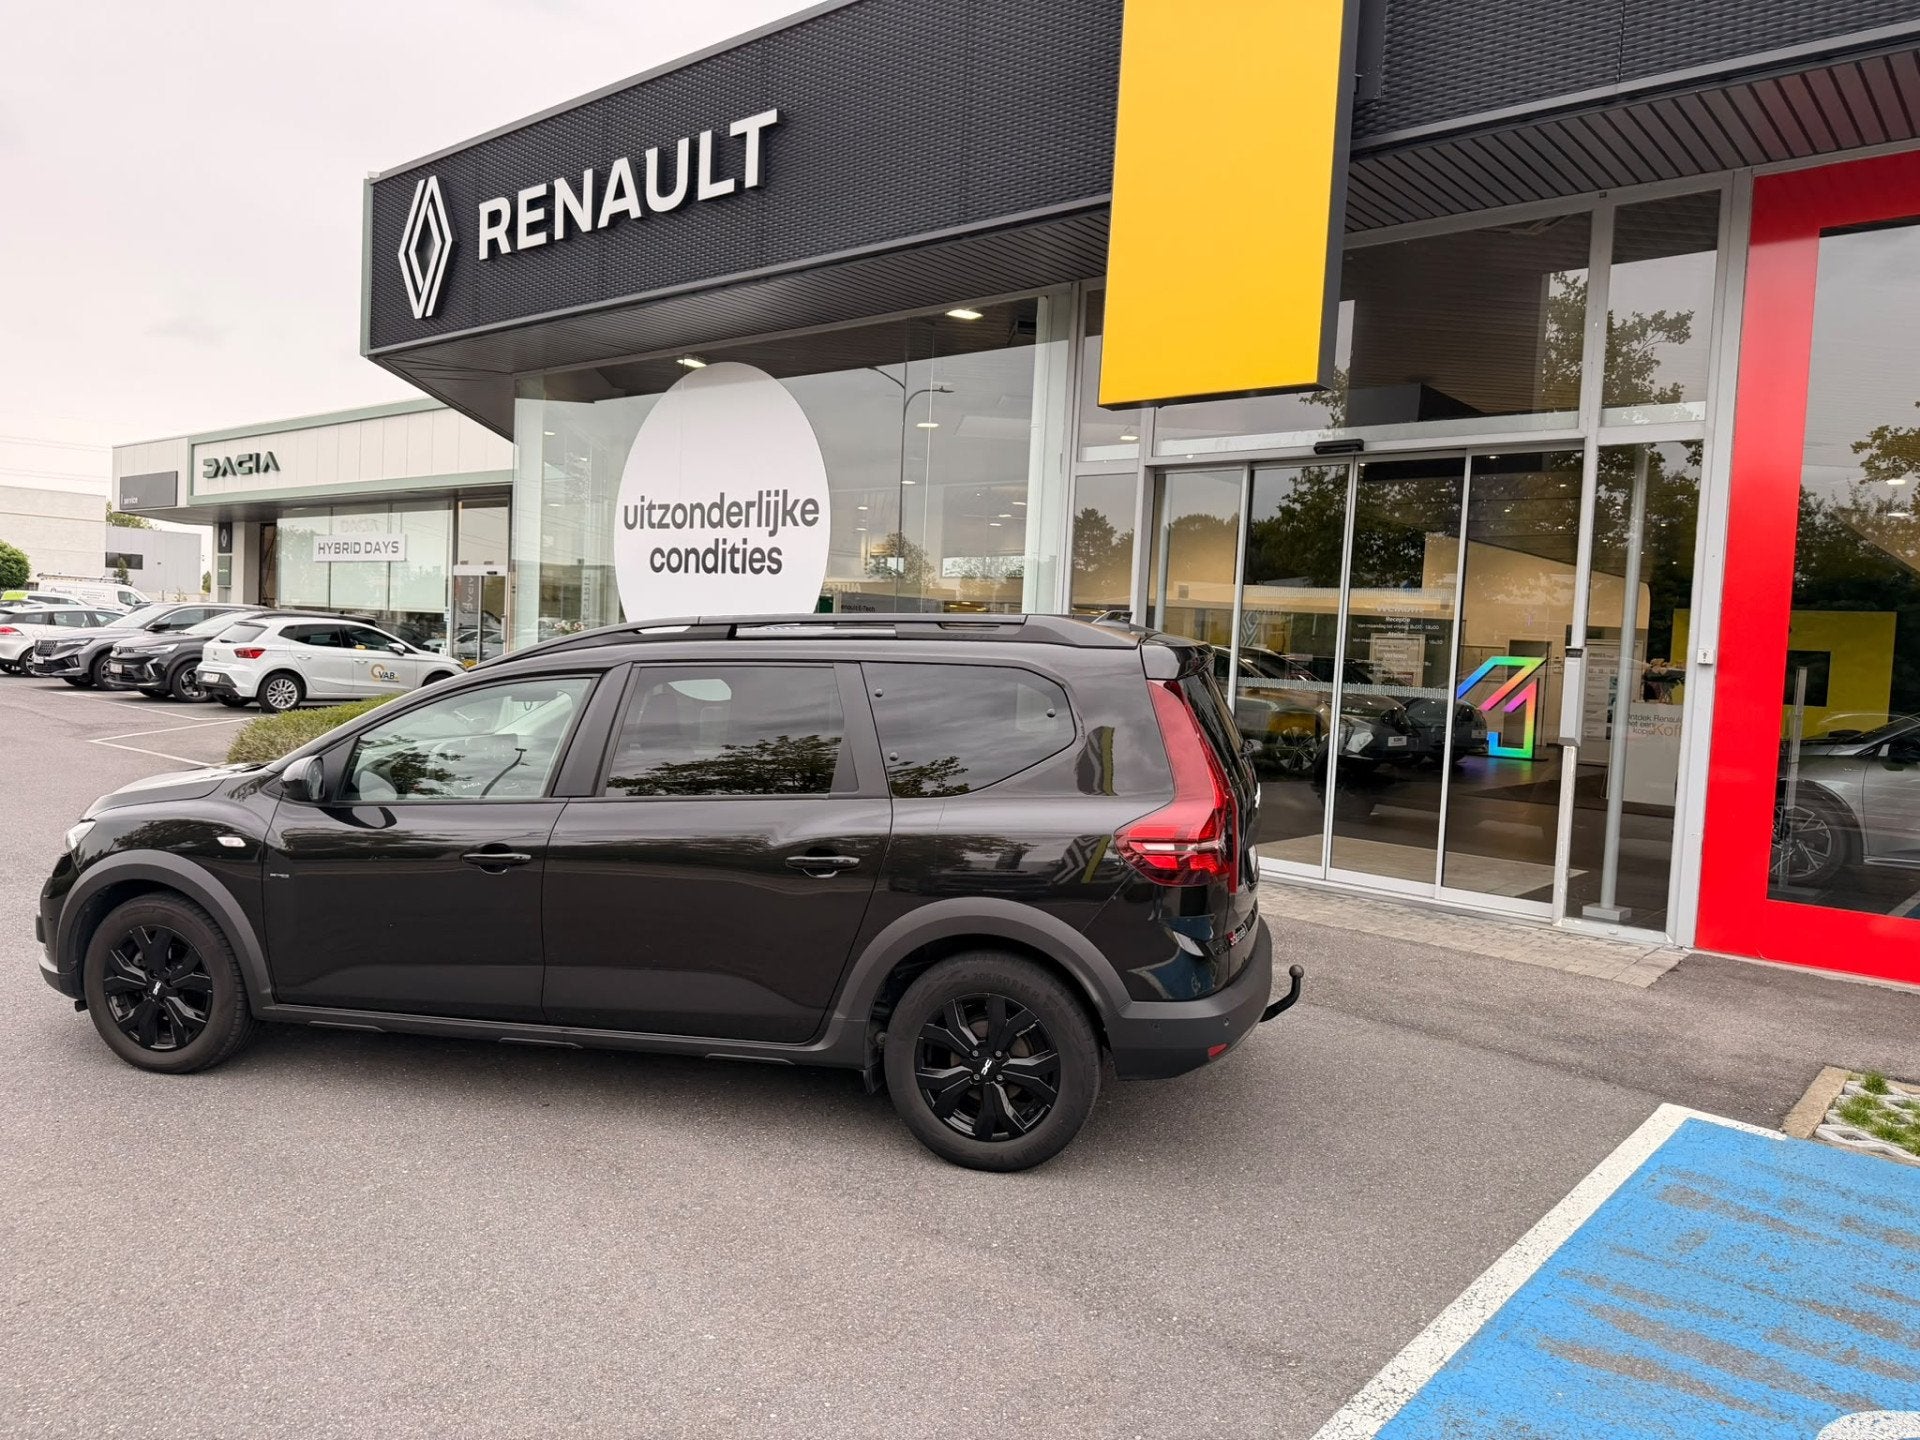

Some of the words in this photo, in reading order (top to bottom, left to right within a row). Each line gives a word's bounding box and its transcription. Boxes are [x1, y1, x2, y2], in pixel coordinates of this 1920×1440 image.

[478, 108, 781, 260] RENAULT
[203, 451, 281, 478] DACIA
[623, 489, 820, 538] uitzonderlijke
[318, 541, 361, 555] HYBRID
[364, 540, 400, 554] DAYS
[649, 538, 783, 575] condities
